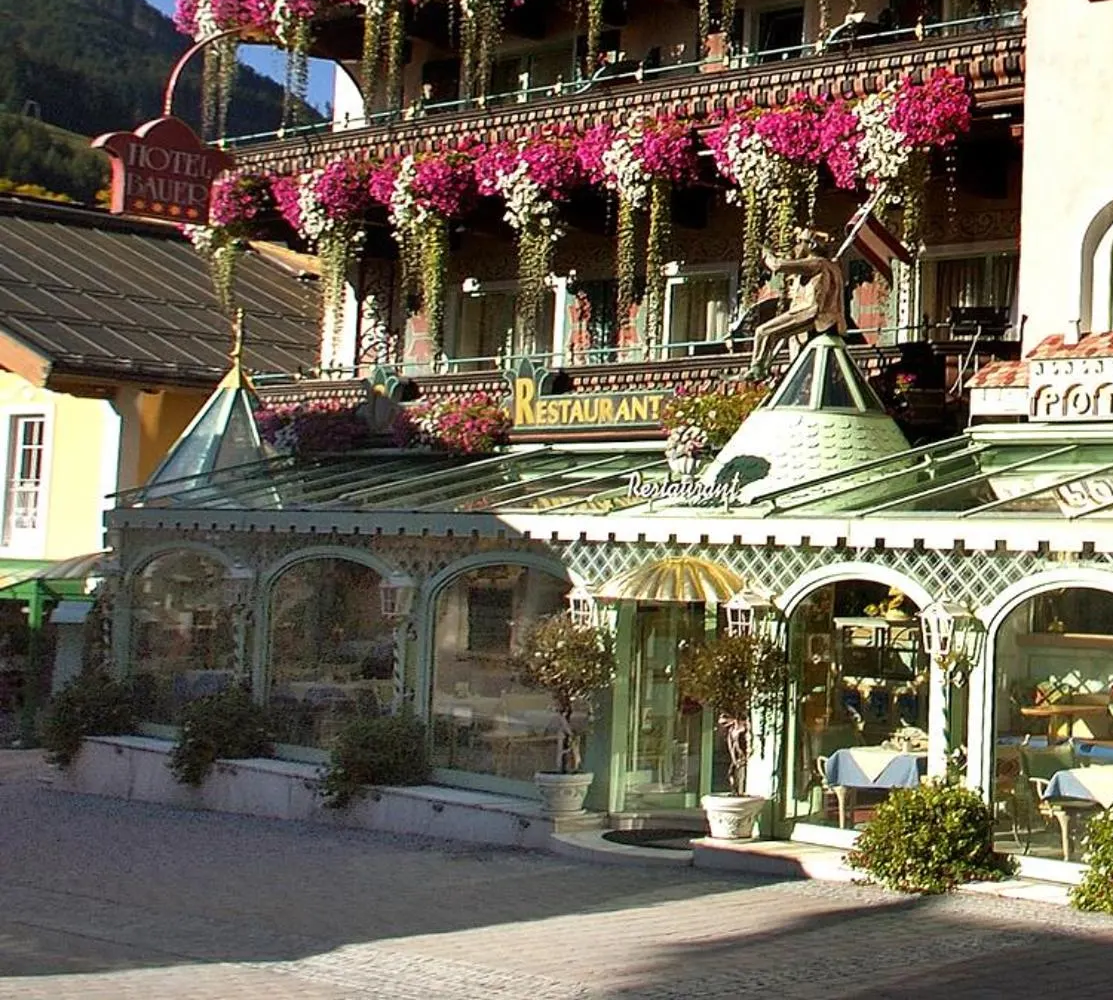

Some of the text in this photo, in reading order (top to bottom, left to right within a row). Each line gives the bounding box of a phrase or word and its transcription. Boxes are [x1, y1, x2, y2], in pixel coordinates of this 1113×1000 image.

[127, 142, 212, 179] HOTEL
[126, 171, 208, 206] BAUER
[514, 377, 664, 426] RESTAURANT
[627, 470, 742, 500] Restaurant
